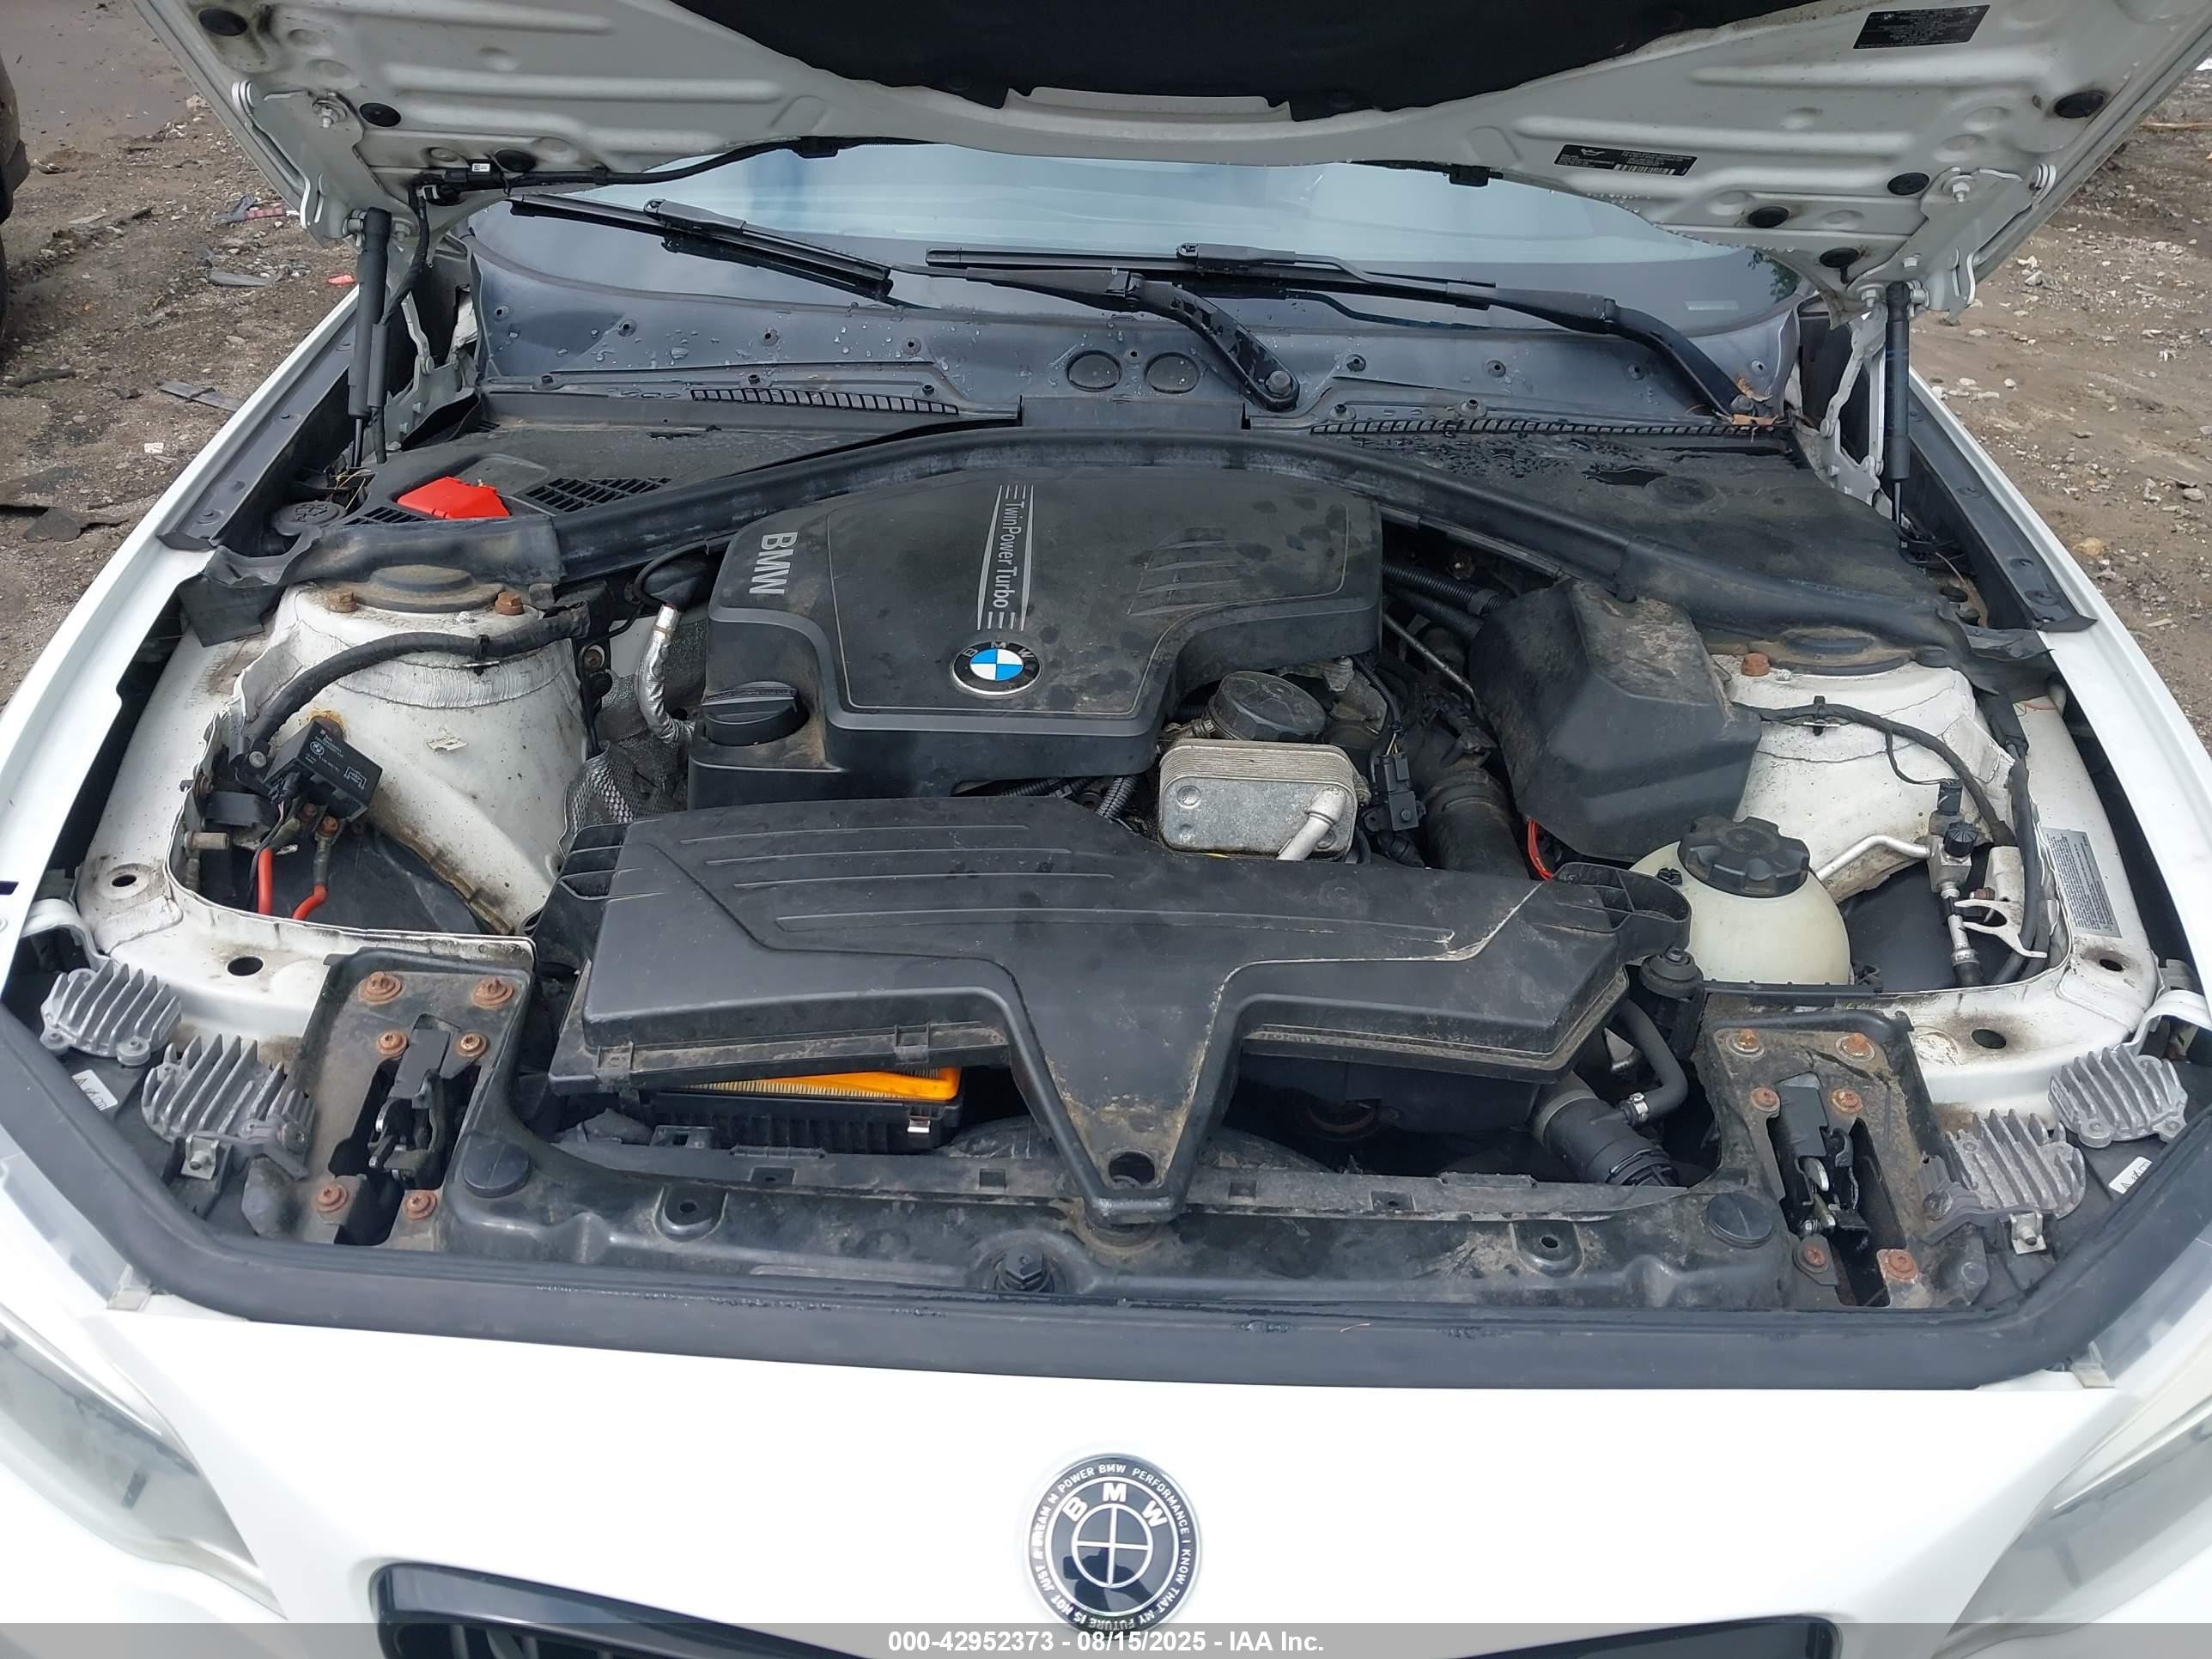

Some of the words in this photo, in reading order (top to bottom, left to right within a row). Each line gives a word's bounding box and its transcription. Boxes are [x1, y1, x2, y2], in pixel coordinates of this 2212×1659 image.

[997, 501, 1025, 565] TwinPower
[749, 530, 799, 595] BMW
[992, 566, 1018, 609] Turbo
[1056, 1467, 1096, 1494] POWER
[1098, 1463, 1127, 1474] BMW
[1061, 1482, 1169, 1528] BMW
[1132, 1468, 1191, 1535] PERFORMANCE
[1035, 1565, 1055, 1592] JUST
[1175, 1548, 1192, 1585] KNOW
[1050, 1594, 1074, 1616] NOT
[1156, 1587, 1181, 1613] THAT
[1073, 1611, 1088, 1625] IS
[1087, 1617, 1136, 1631] FUTURE
[1138, 1609, 1156, 1626] MY
